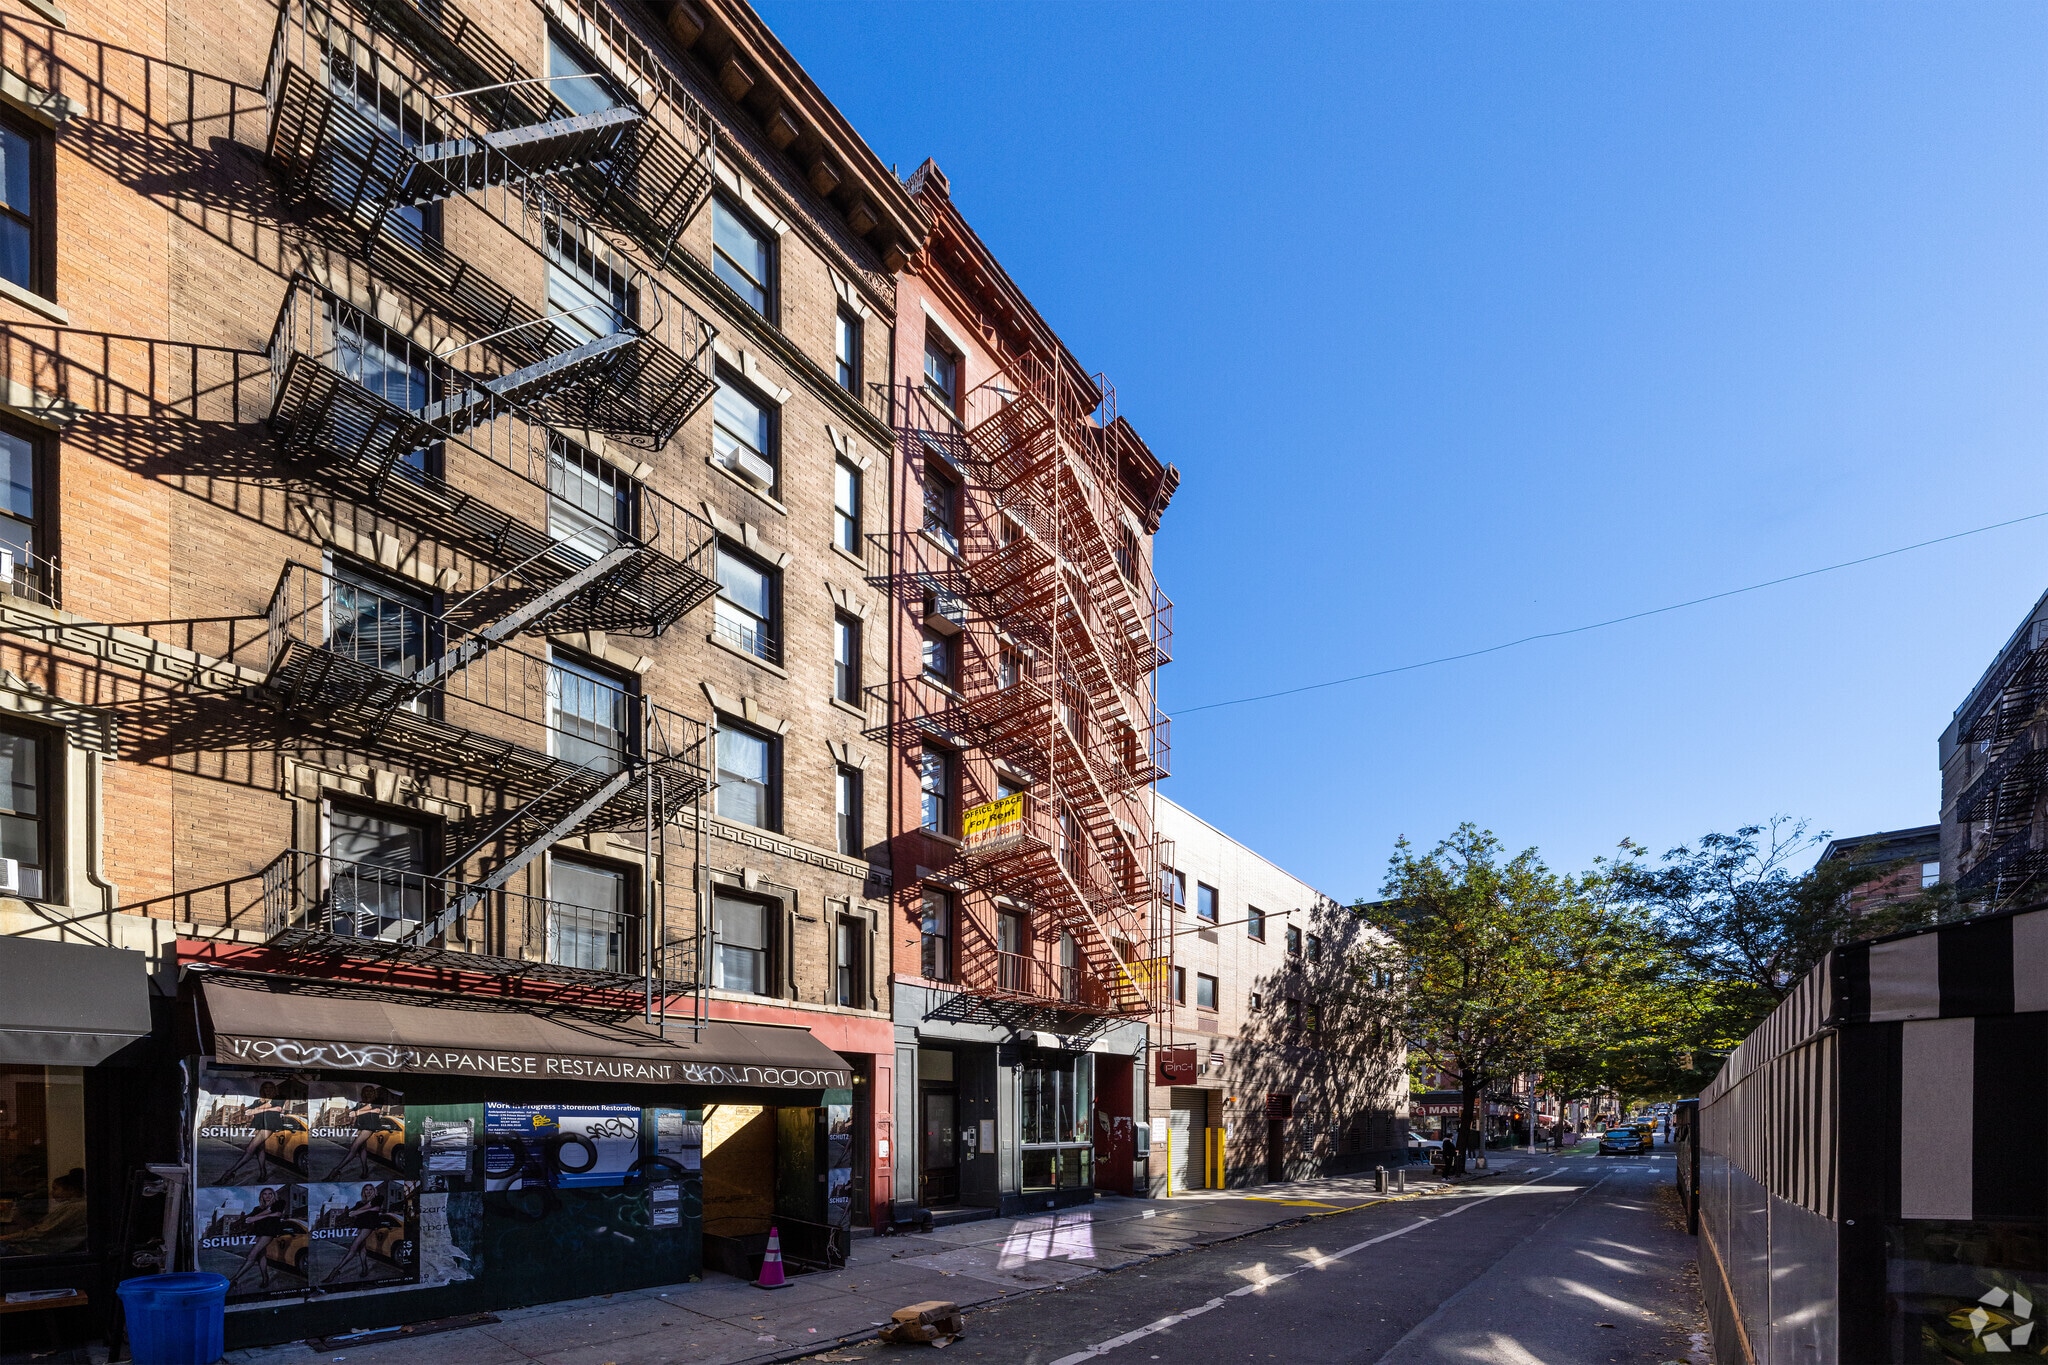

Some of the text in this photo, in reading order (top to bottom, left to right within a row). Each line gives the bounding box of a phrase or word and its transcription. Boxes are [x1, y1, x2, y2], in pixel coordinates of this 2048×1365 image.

[964, 795, 1022, 819] OFFICE SPACE
[969, 808, 1016, 829] For Rent
[233, 1038, 277, 1059] 179
[411, 1051, 537, 1074] JAPANESE
[545, 1057, 672, 1081] RESTAURANT
[743, 1066, 846, 1087] nagomi
[522, 1103, 556, 1111] Progress
[601, 1104, 641, 1112] Restoration
[201, 1126, 256, 1138] SCHUTZ
[311, 1127, 359, 1138] SCHUTZ
[829, 1133, 850, 1142] SCHUTZ
[829, 1196, 849, 1205] SCHUTZ
[311, 1226, 359, 1240] SCHUTZ
[202, 1234, 257, 1249] SCHUTZ
